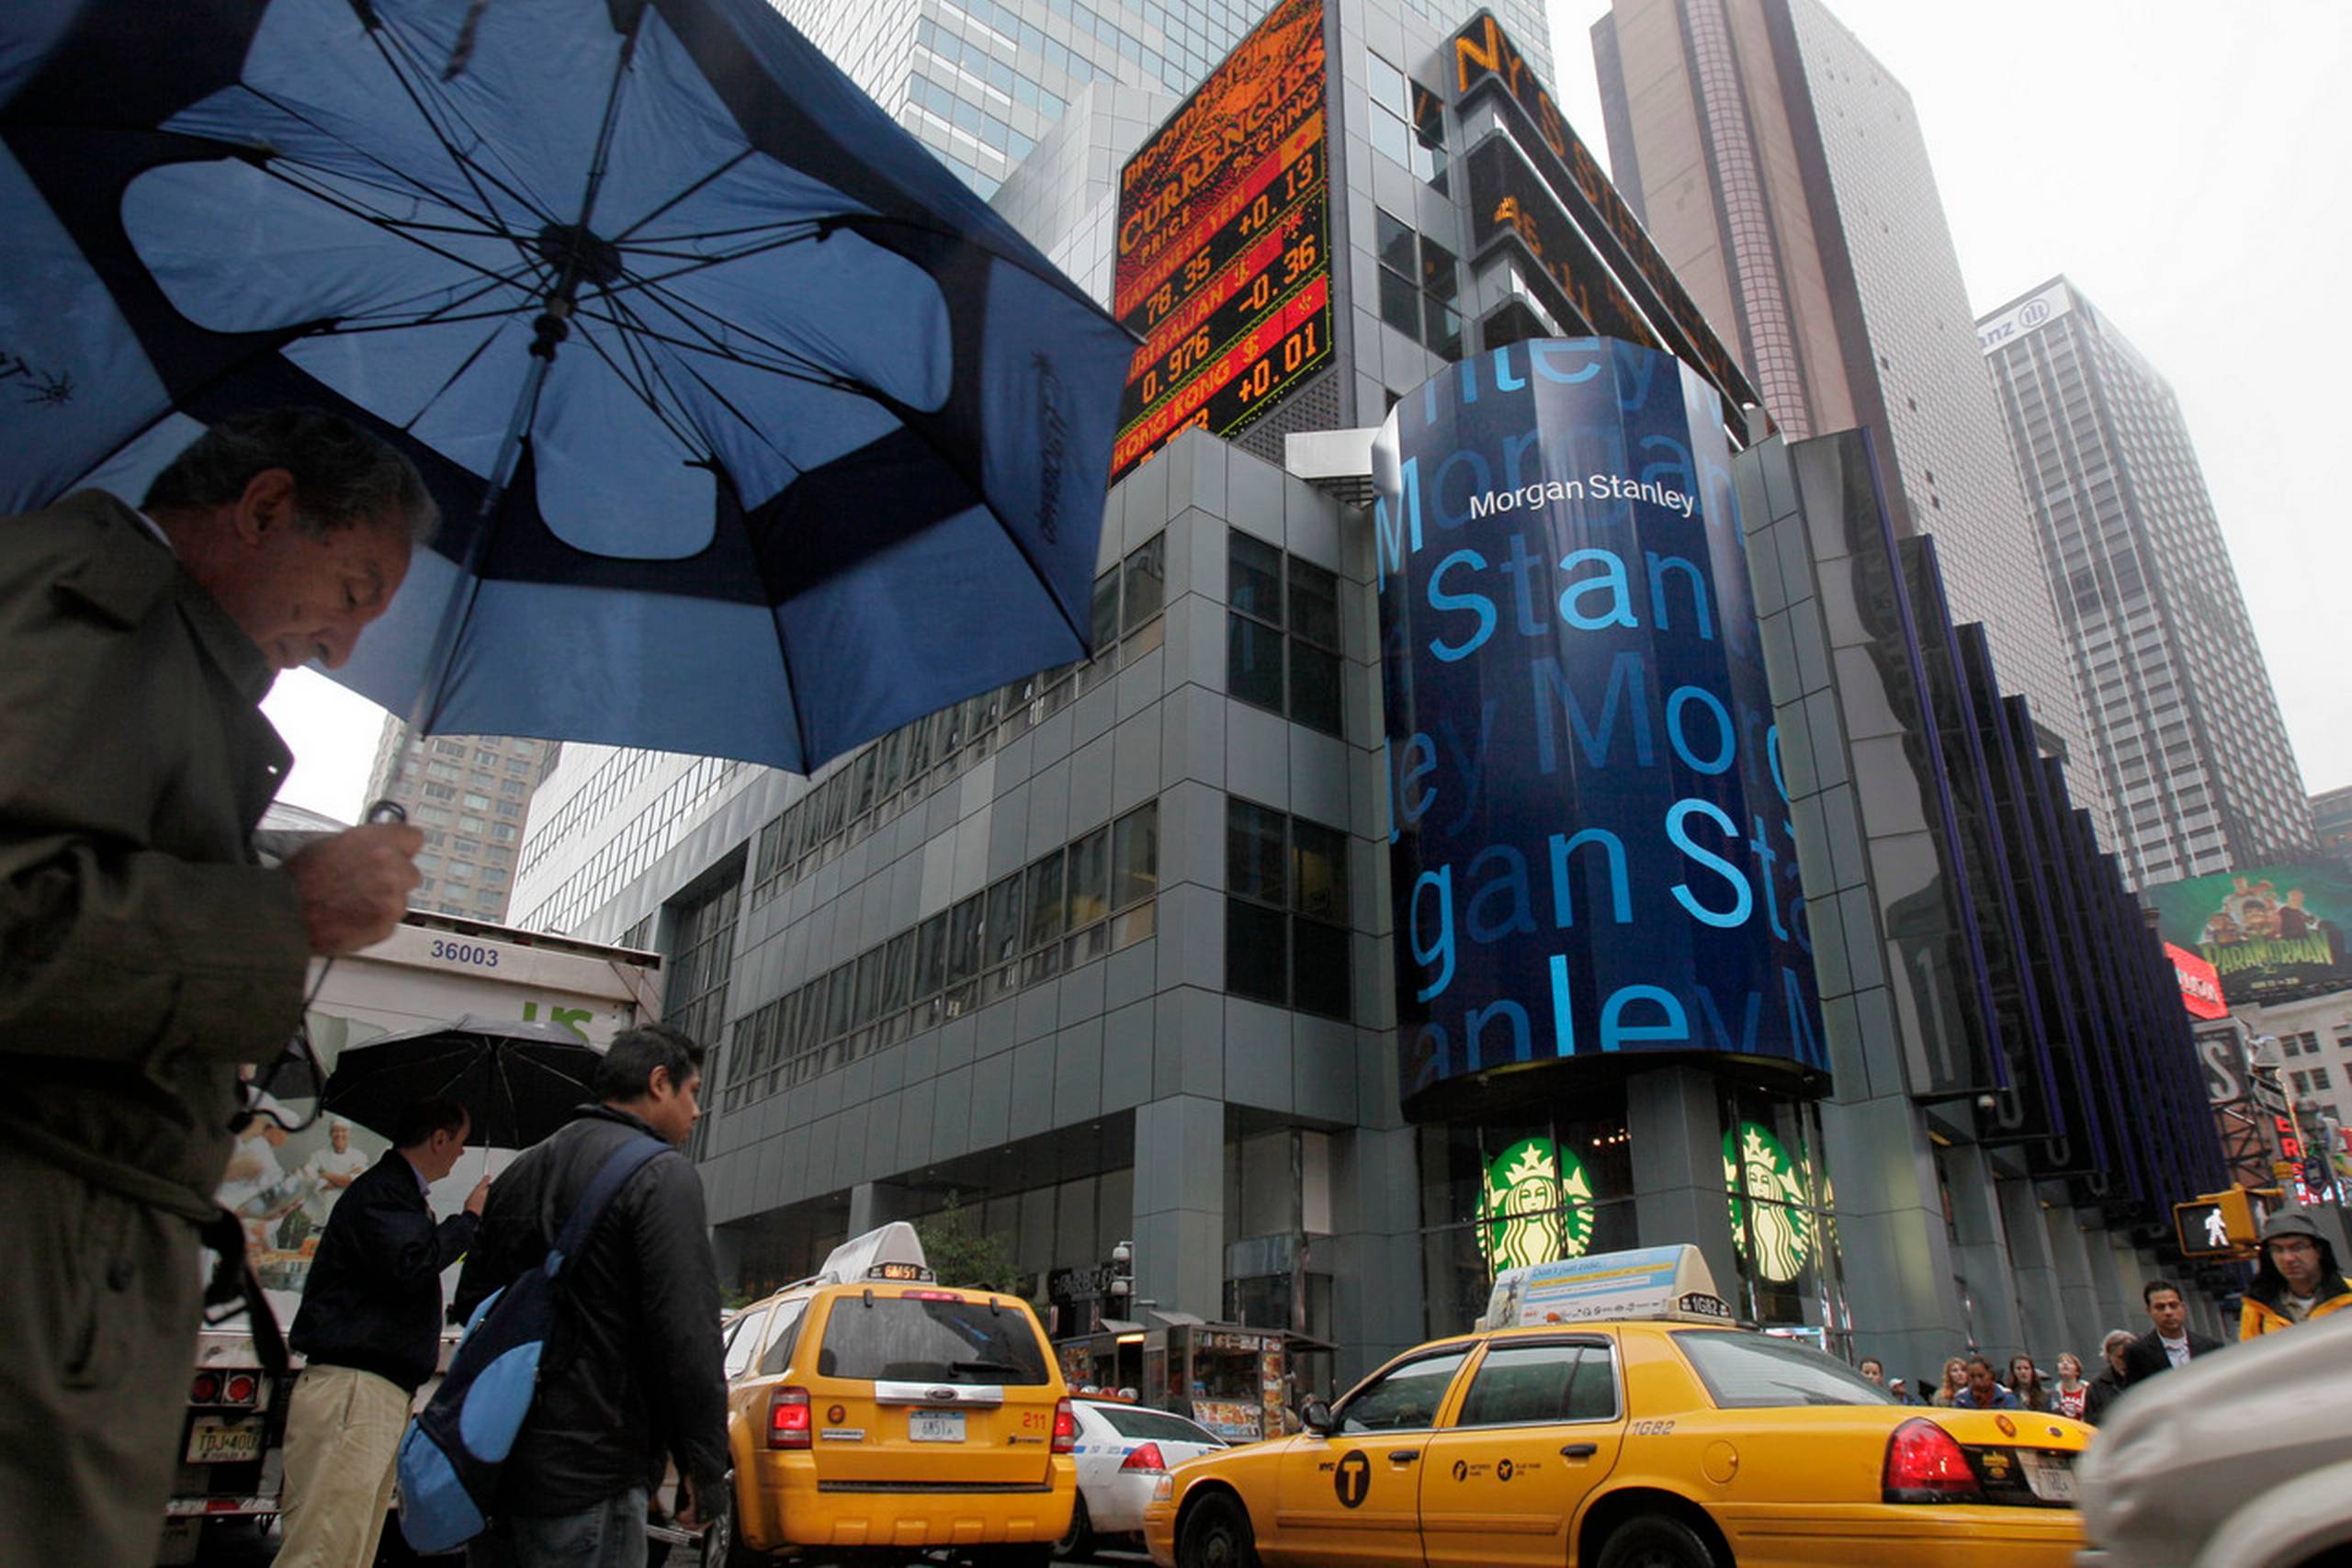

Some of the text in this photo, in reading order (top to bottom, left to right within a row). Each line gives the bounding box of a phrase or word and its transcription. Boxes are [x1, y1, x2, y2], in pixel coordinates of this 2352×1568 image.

[1140, 204, 1191, 266] PRICE
[1146, 153, 1314, 325] 78.35 +0.13
[1210, 186, 1247, 232] YEN
[1142, 234, 1317, 404] 0.976 -0.36
[1238, 322, 1317, 403] +0.01
[1113, 411, 1170, 471] HONG
[1173, 359, 1231, 421] KONG
[1469, 474, 1695, 520] Morgan Stanley
[1410, 827, 1634, 1004] gan
[431, 939, 499, 967] 36003
[1632, 1419, 1676, 1436] 1G82
